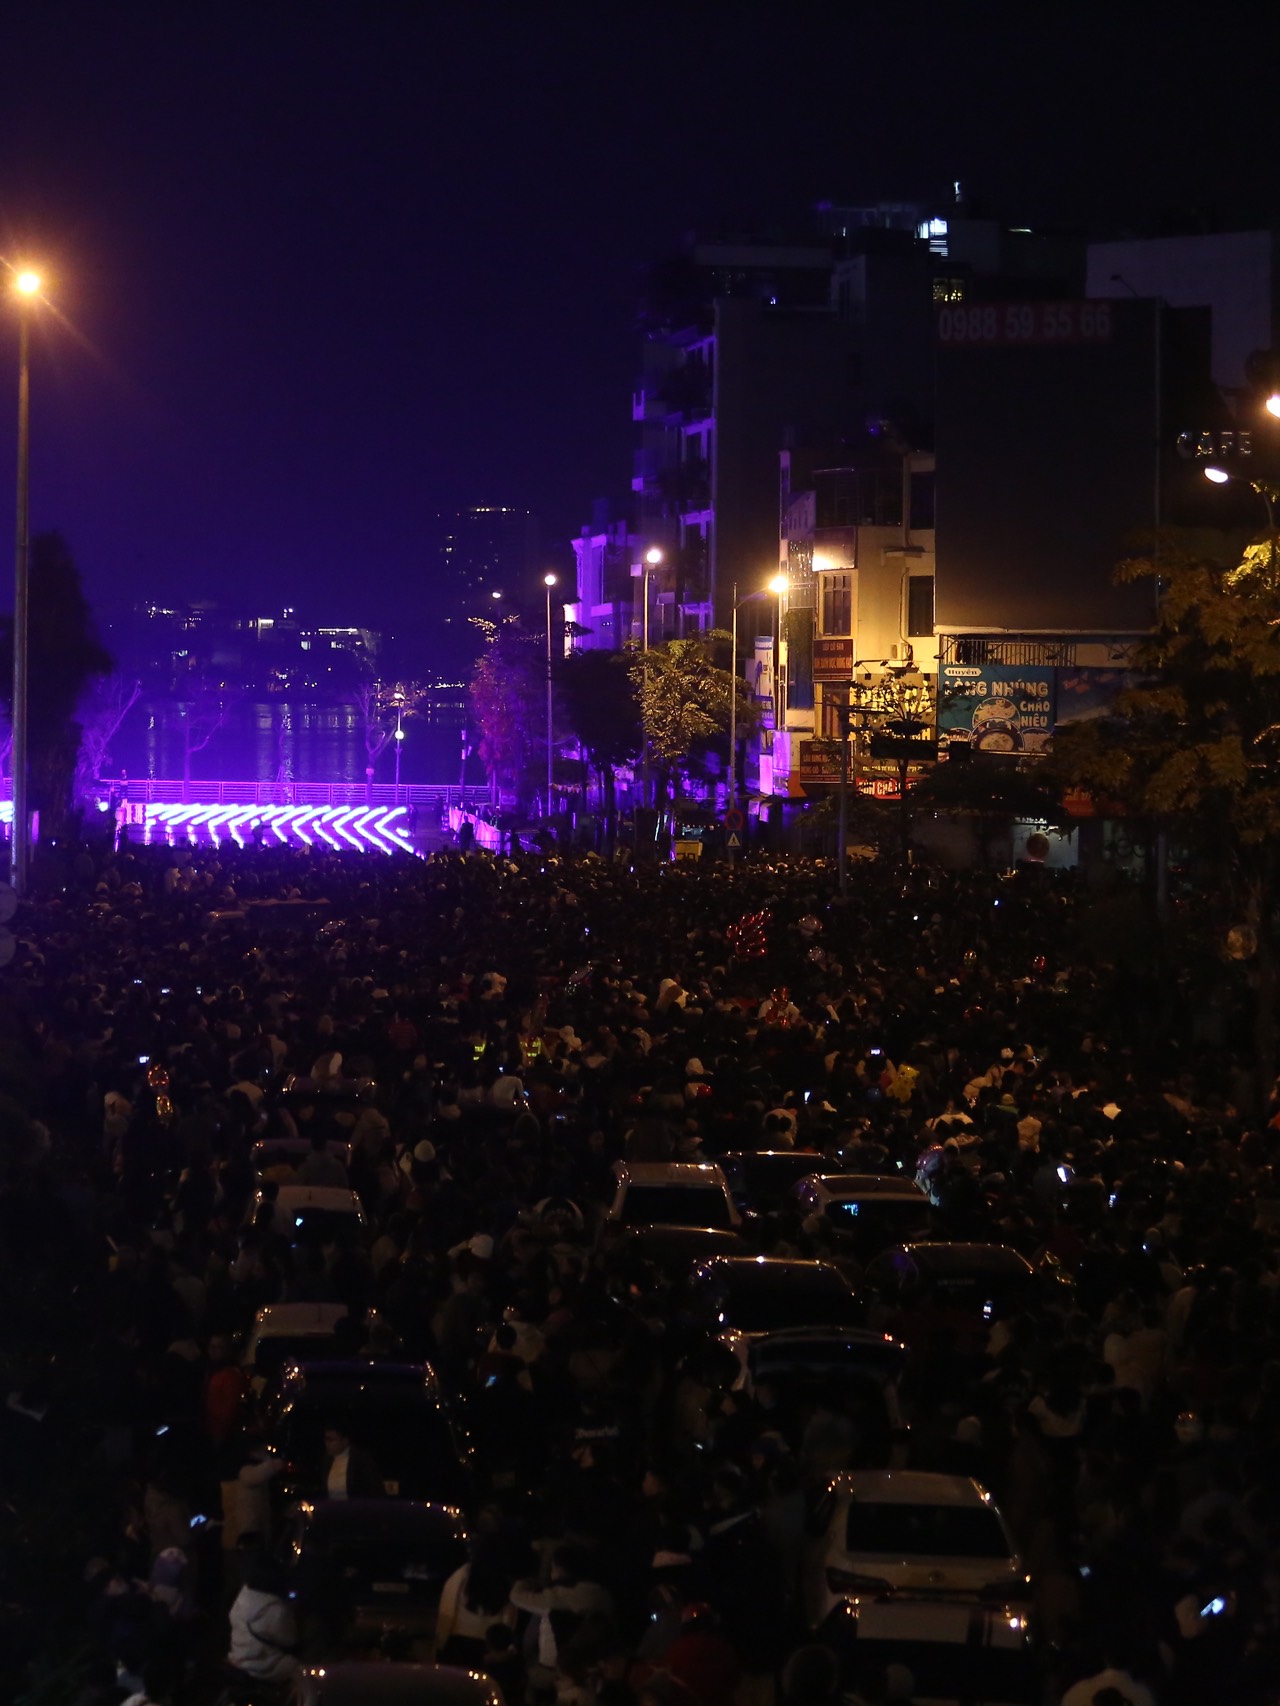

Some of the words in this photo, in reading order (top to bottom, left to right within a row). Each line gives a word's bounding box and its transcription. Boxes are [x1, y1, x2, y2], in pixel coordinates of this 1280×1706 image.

[938, 306, 997, 341] 0988
[1005, 305, 1034, 339] 59
[1043, 304, 1072, 338] 55
[1080, 303, 1111, 337] 66
